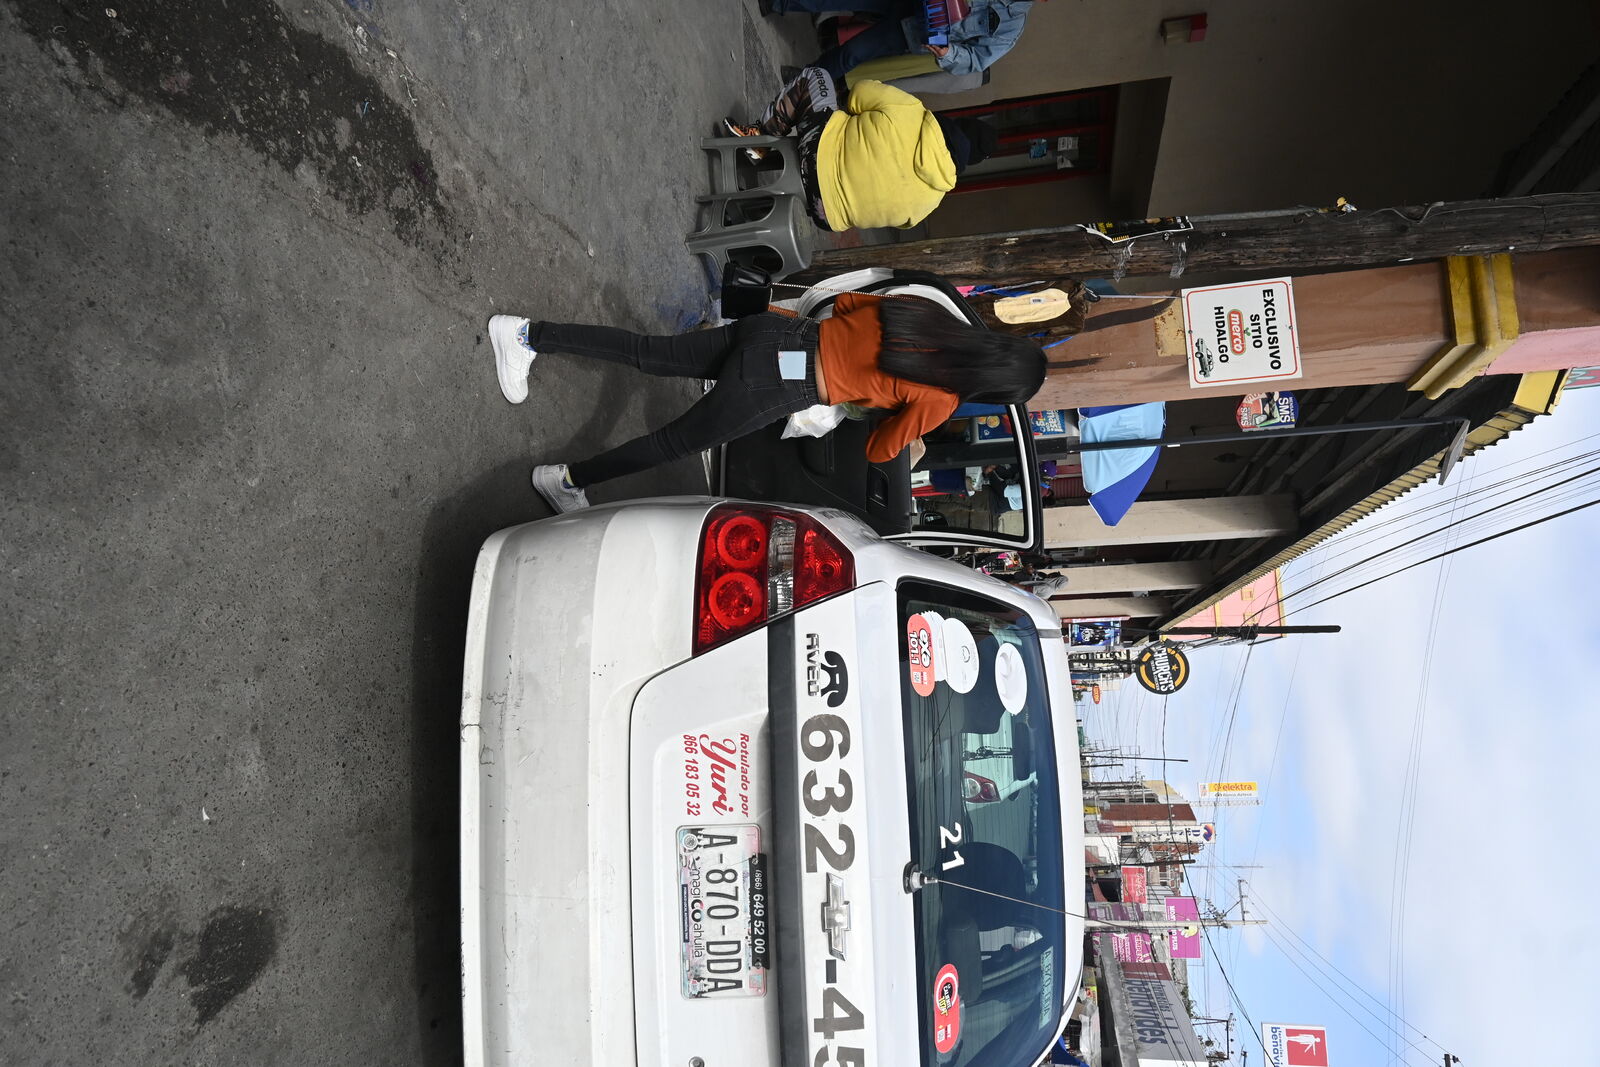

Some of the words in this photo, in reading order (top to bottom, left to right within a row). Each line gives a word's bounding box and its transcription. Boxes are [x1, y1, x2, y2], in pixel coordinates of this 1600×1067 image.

[1214, 306, 1229, 364] HIDALGO
[1230, 312, 1242, 352] merco
[1250, 314, 1262, 348] SITIO
[1262, 288, 1282, 370] EXCLUSIVO
[1278, 397, 1290, 422] SMS
[806, 634, 820, 696] AVEO
[910, 632, 920, 664] 101.1
[918, 629, 932, 668] exa
[684, 734, 698, 754] 866
[685, 758, 698, 780] 183
[700, 734, 736, 816] Yuri
[740, 734, 750, 790] Rotulado
[686, 783, 700, 798] 05
[800, 714, 856, 874] 632
[1222, 783, 1253, 791] elektra
[686, 801, 700, 816] 32
[739, 793, 748, 818] por
[940, 822, 964, 871] 21
[754, 870, 762, 890] (866)
[703, 834, 742, 992] A-870-DDA
[753, 894, 764, 916] 649
[754, 920, 764, 934] 52
[754, 938, 765, 954] 00
[1126, 980, 1179, 1044] benavides
[1271, 1027, 1283, 1067] benavi
